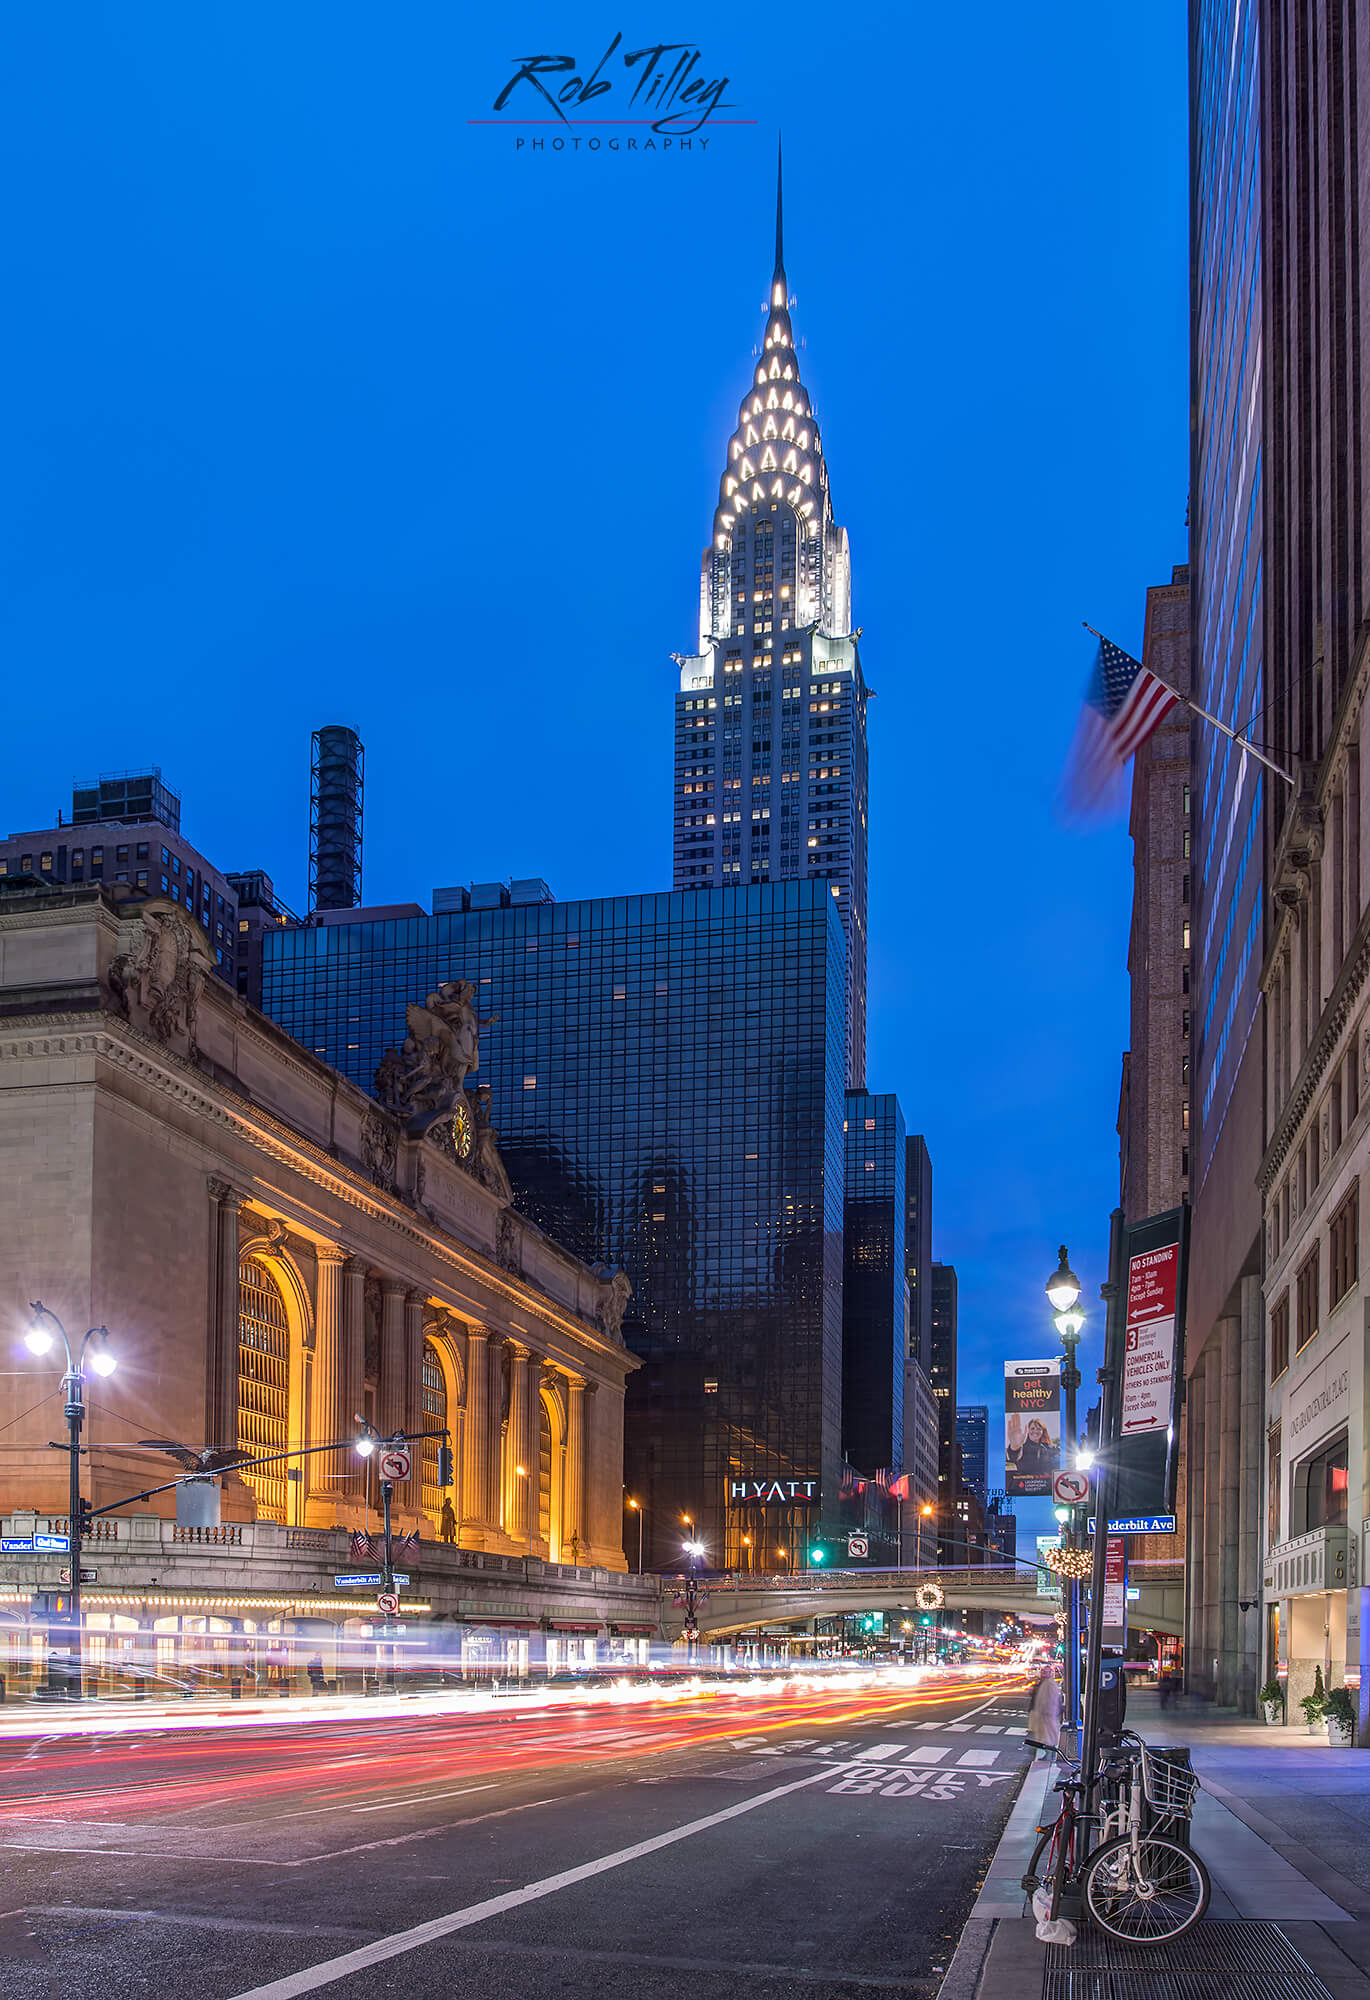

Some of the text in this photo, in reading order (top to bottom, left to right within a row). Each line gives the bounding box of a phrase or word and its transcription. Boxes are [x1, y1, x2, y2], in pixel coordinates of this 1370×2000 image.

[1131, 1250, 1173, 1271] NO STANDING
[1130, 1287, 1164, 1302] Except Sunday
[1127, 1330, 1137, 1351] 3
[1126, 1350, 1164, 1366] COMMERCIAL
[1126, 1360, 1170, 1377] VEHICLES ONLY
[1024, 1379, 1041, 1390] get
[1125, 1374, 1172, 1390] OTHERS NO STANDING
[1012, 1389, 1052, 1399] healthy
[1021, 1398, 1045, 1408] NYC
[1124, 1399, 1157, 1412] Except Sunday
[732, 1481, 816, 1501] HYATT
[1090, 1519, 1173, 1531] Vnderbilt Ave
[1102, 1671, 1113, 1687] P
[842, 1767, 1013, 1787] ONLY
[825, 1779, 965, 1800] BUS
